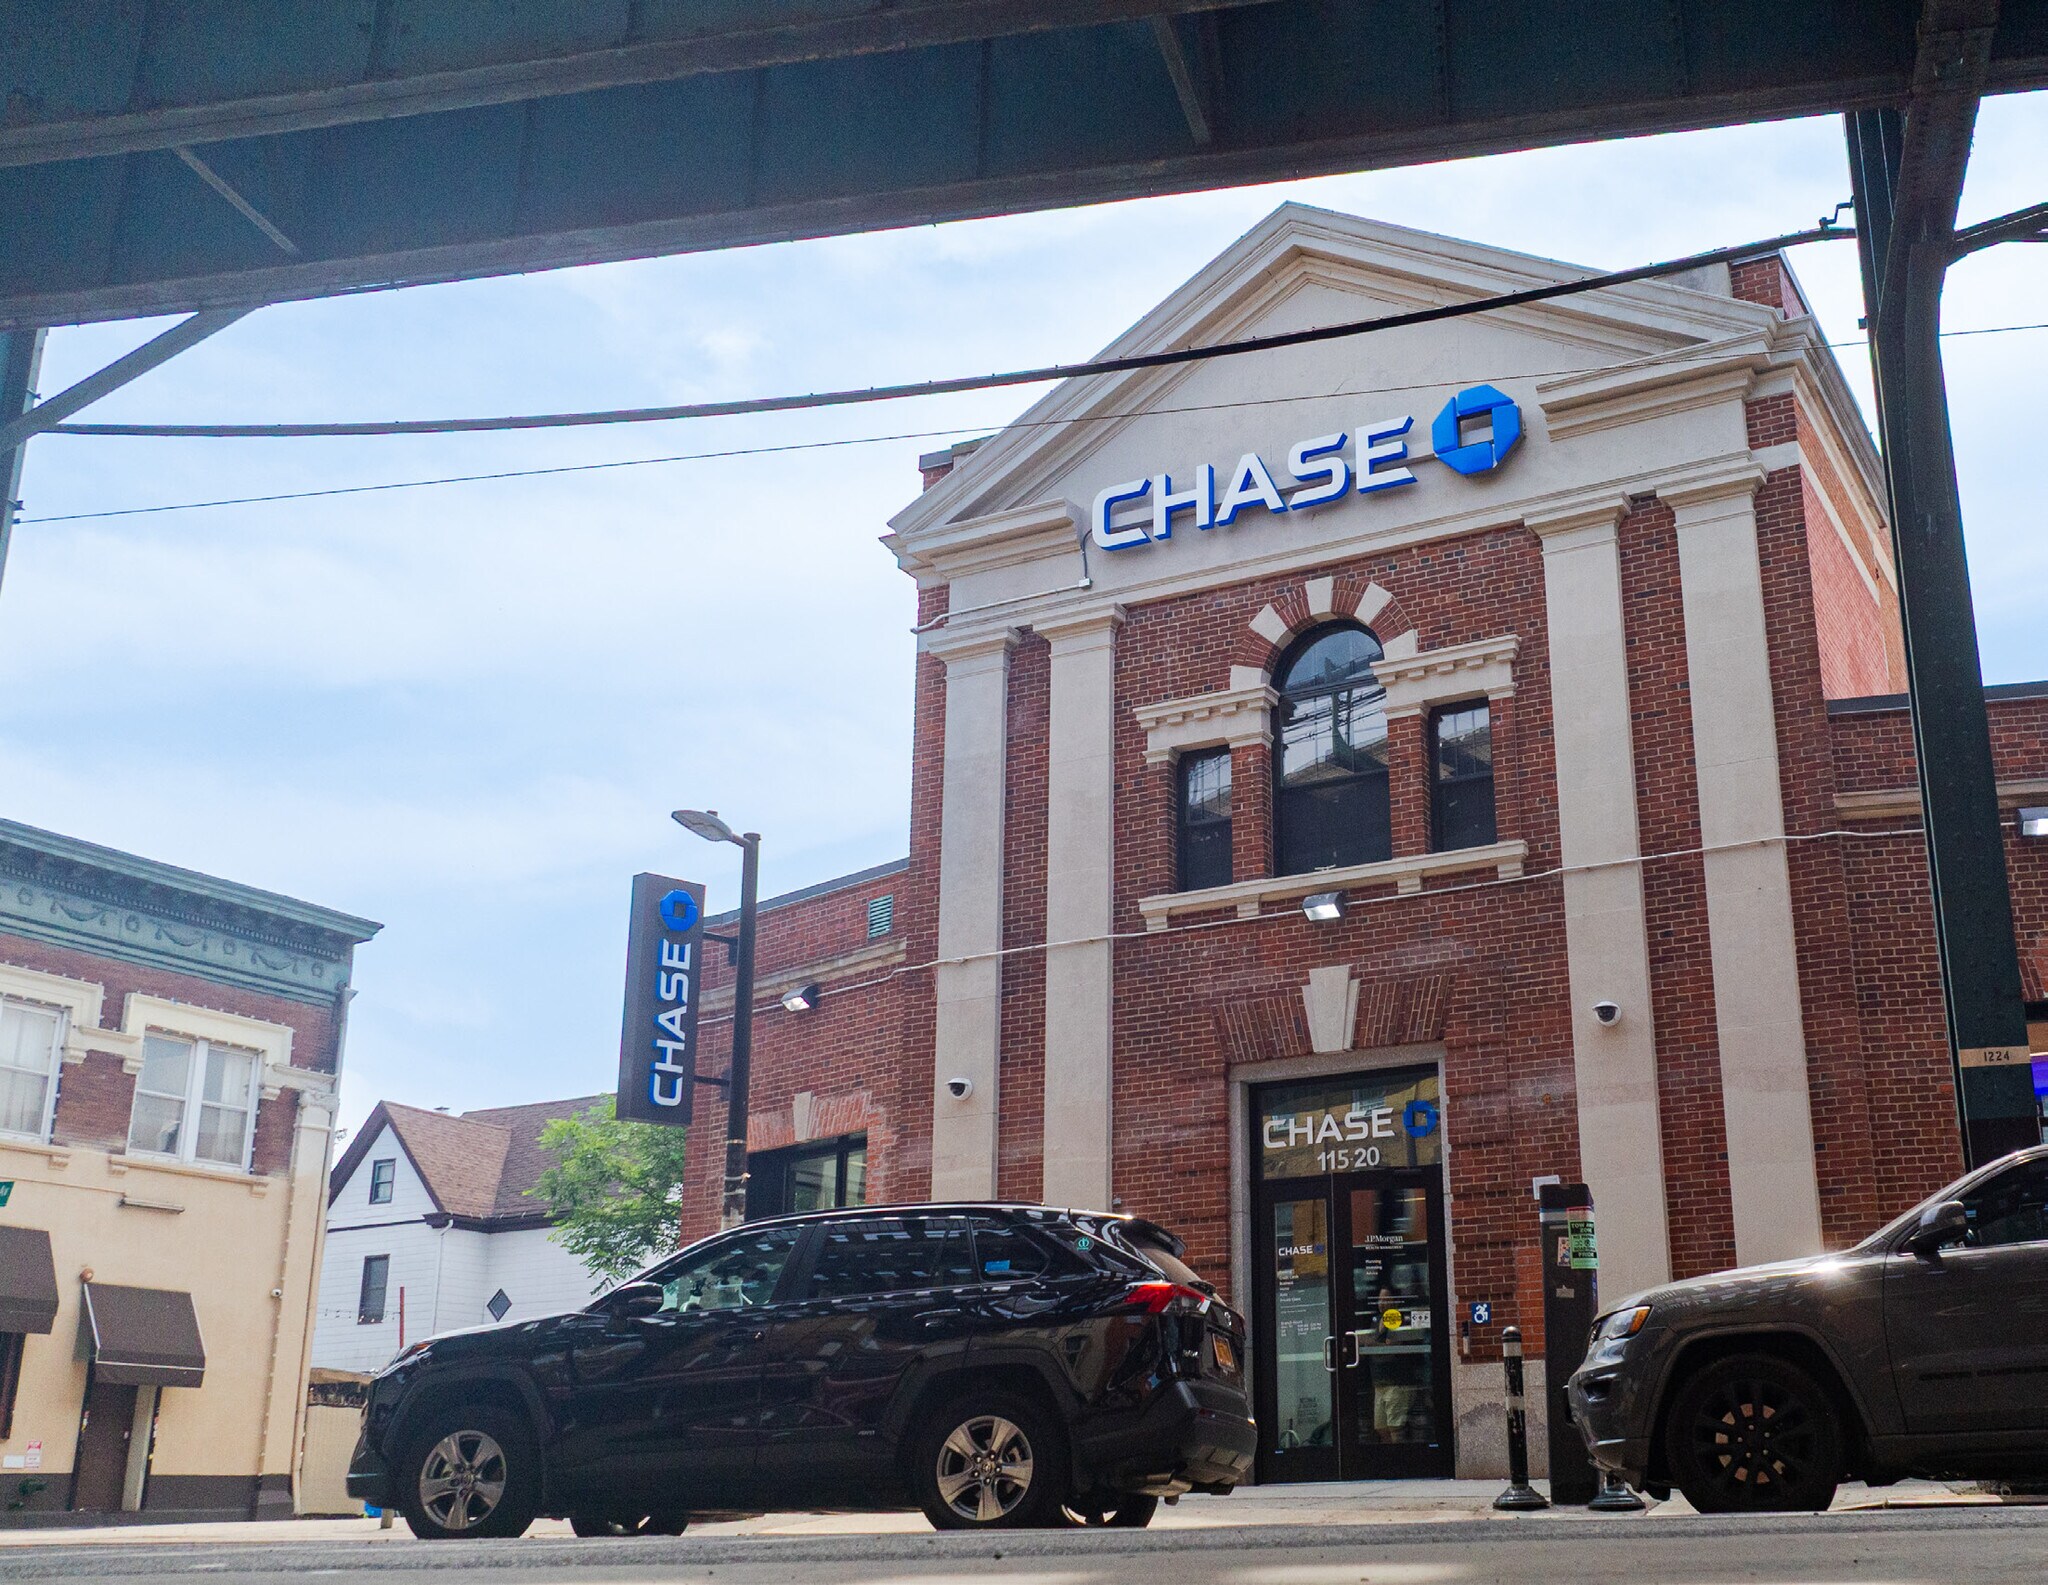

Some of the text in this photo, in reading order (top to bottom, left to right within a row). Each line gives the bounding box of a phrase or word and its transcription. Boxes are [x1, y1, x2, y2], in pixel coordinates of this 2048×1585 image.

[1091, 415, 1418, 551] CHASE
[649, 938, 691, 1107] CHASE
[1984, 1051, 2010, 1062] 1224
[1263, 1107, 1395, 1149] CHASE
[1278, 1244, 1314, 1257] CHASE
